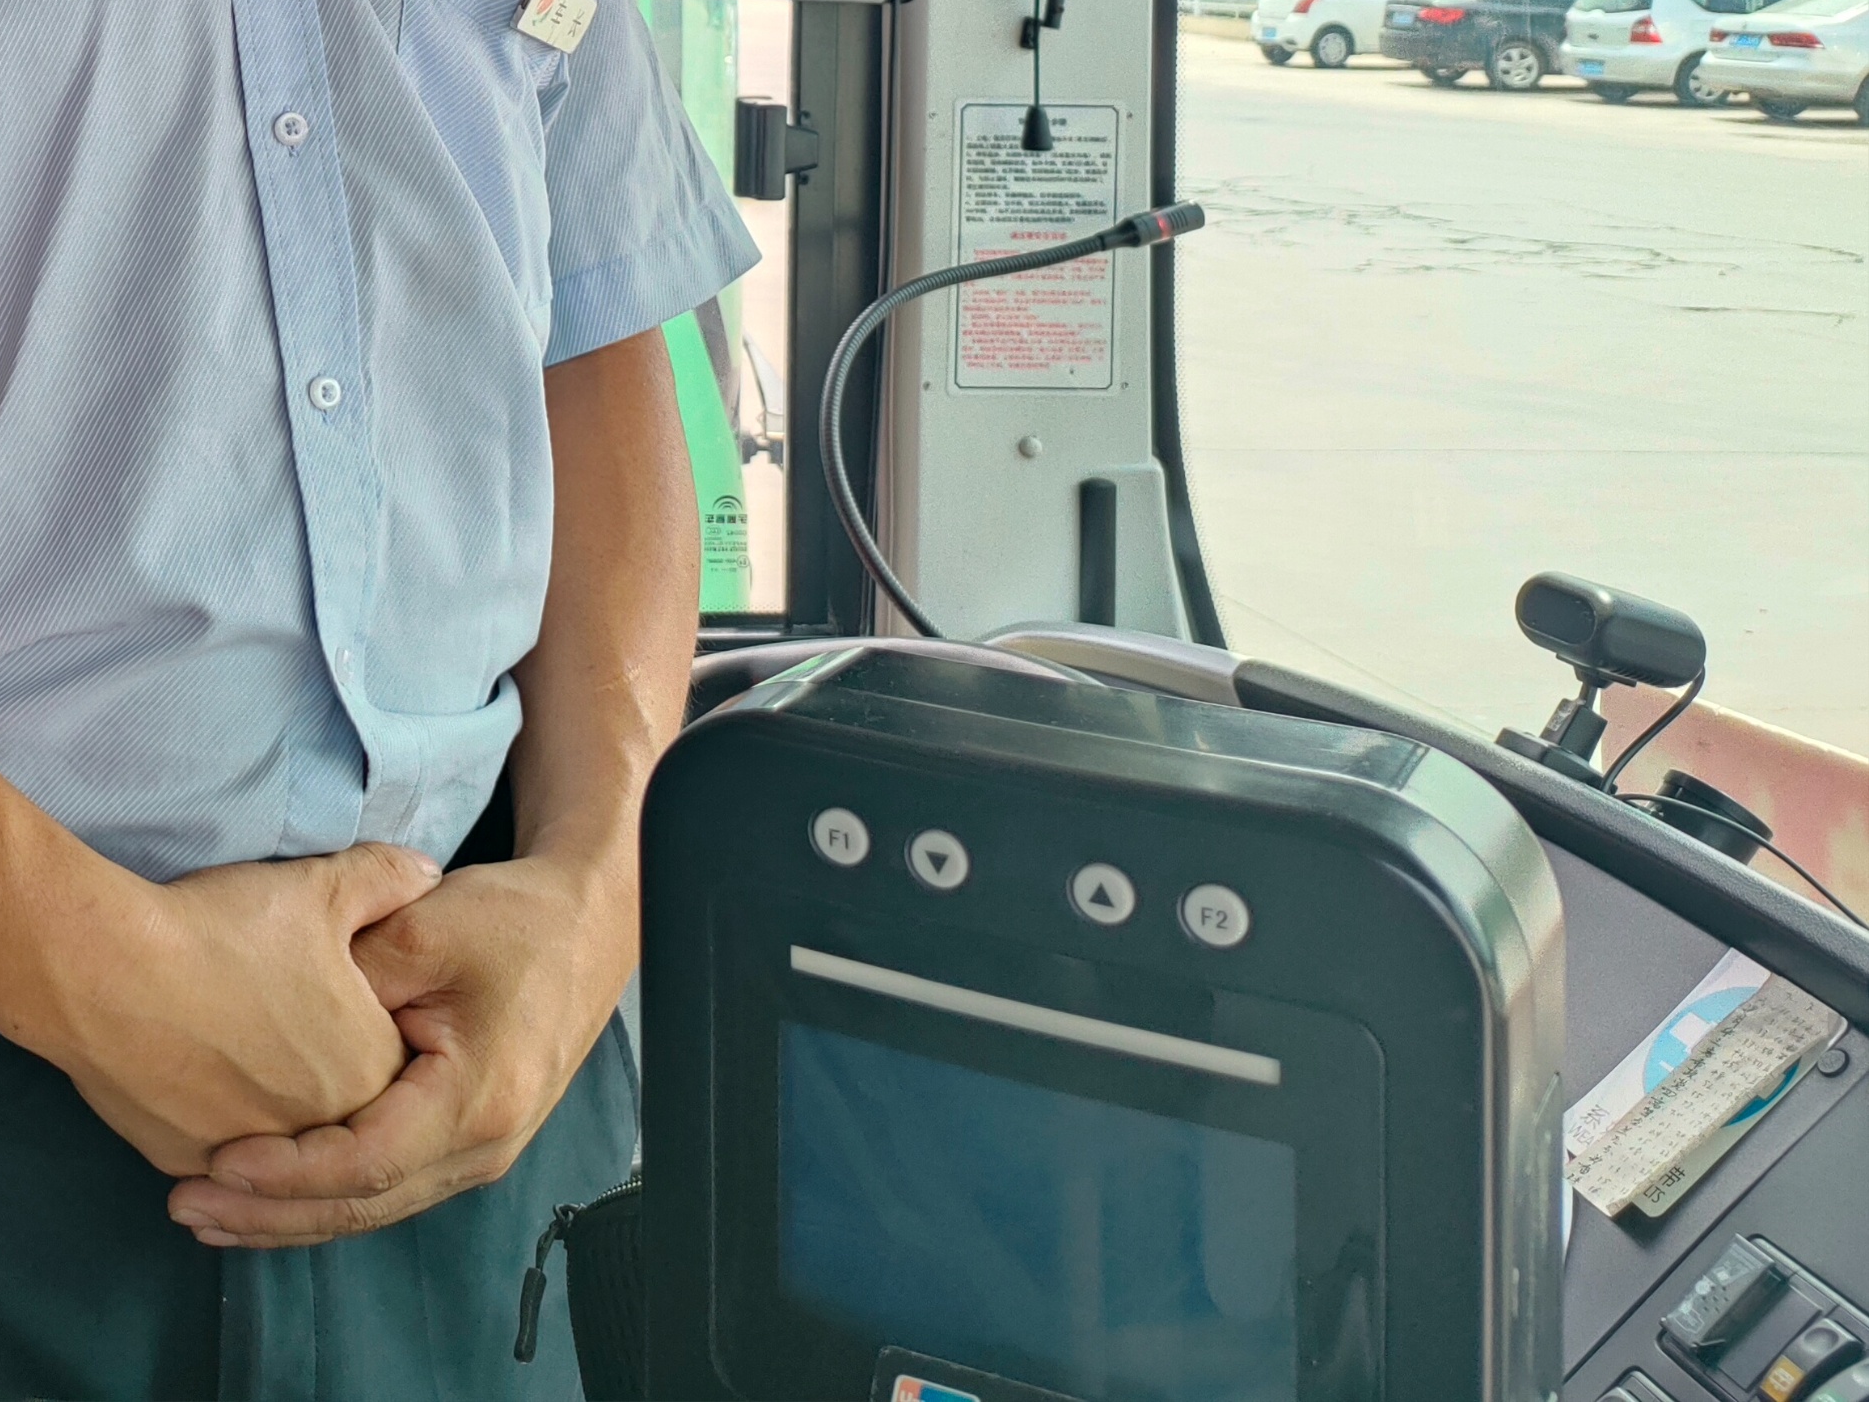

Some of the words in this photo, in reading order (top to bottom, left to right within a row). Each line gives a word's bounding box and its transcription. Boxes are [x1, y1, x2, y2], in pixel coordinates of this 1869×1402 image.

[829, 827, 850, 850] F1
[1199, 906, 1229, 930] F2
[1568, 1124, 1594, 1147] WEA
